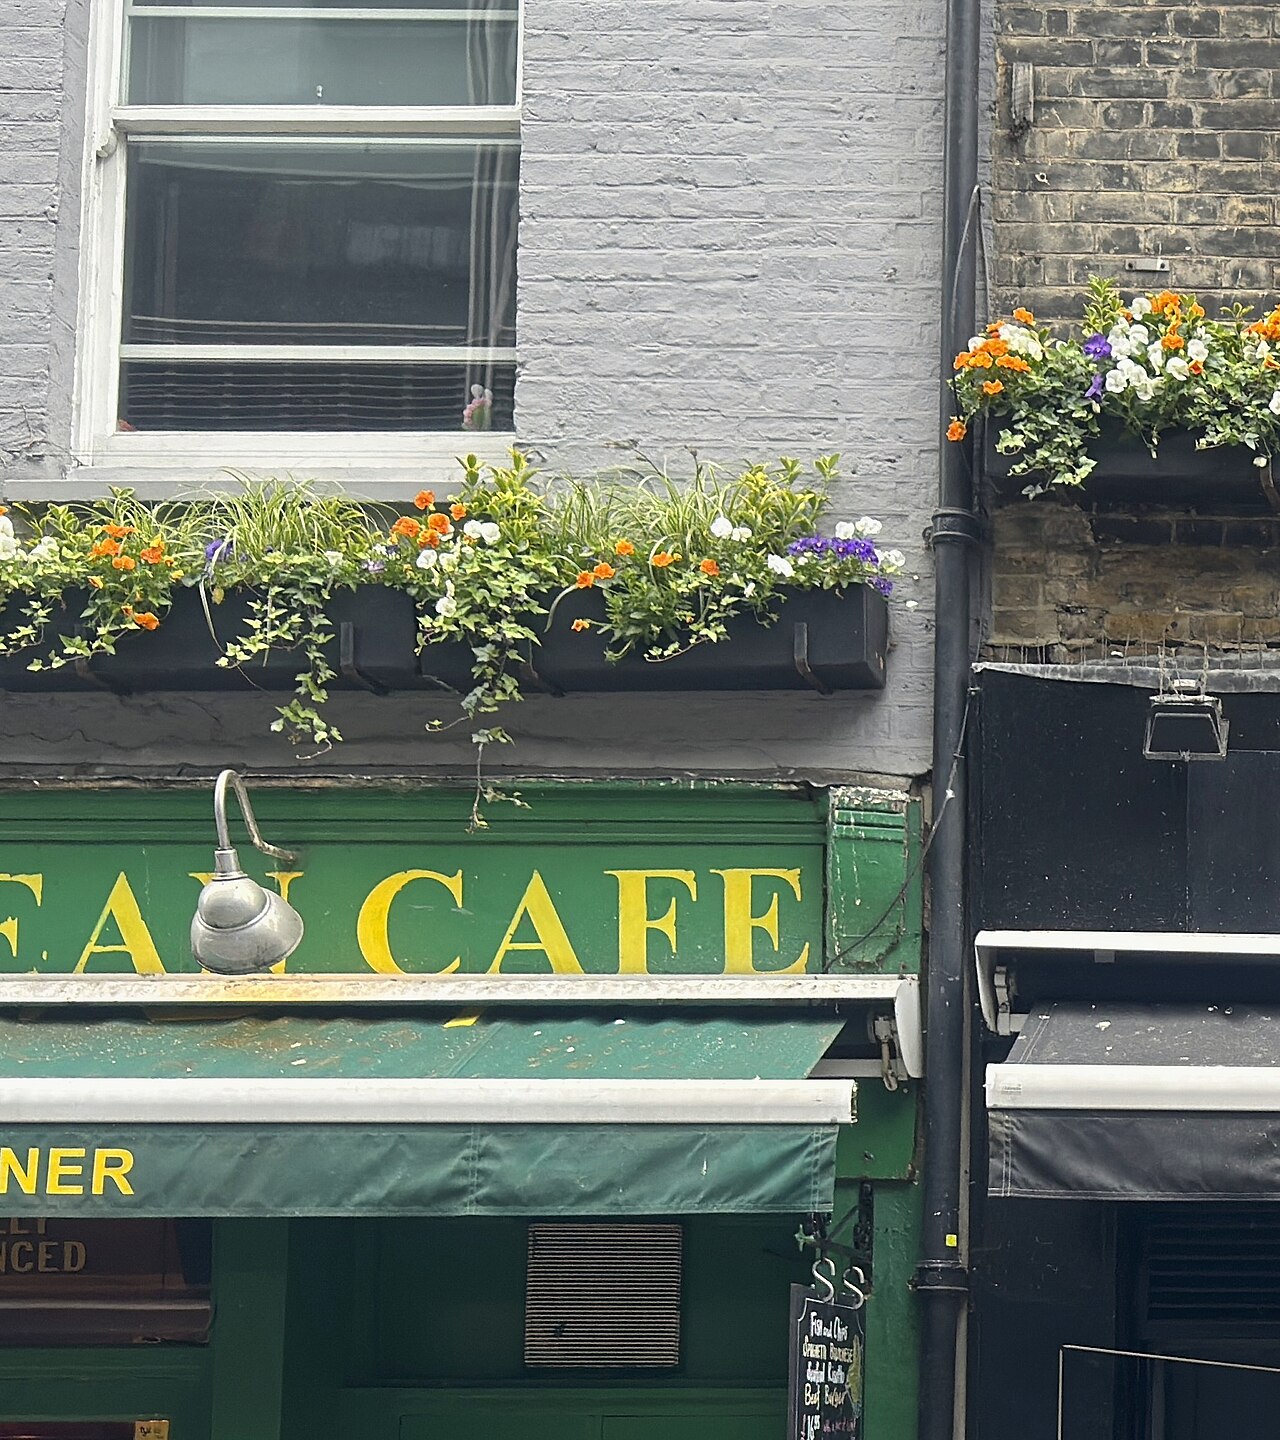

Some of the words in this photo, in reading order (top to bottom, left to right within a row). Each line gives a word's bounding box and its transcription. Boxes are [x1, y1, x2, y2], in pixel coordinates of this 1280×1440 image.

[357, 868, 809, 974] CAFE
[0, 1147, 135, 1195] NER
[0, 1241, 87, 1273] CED
